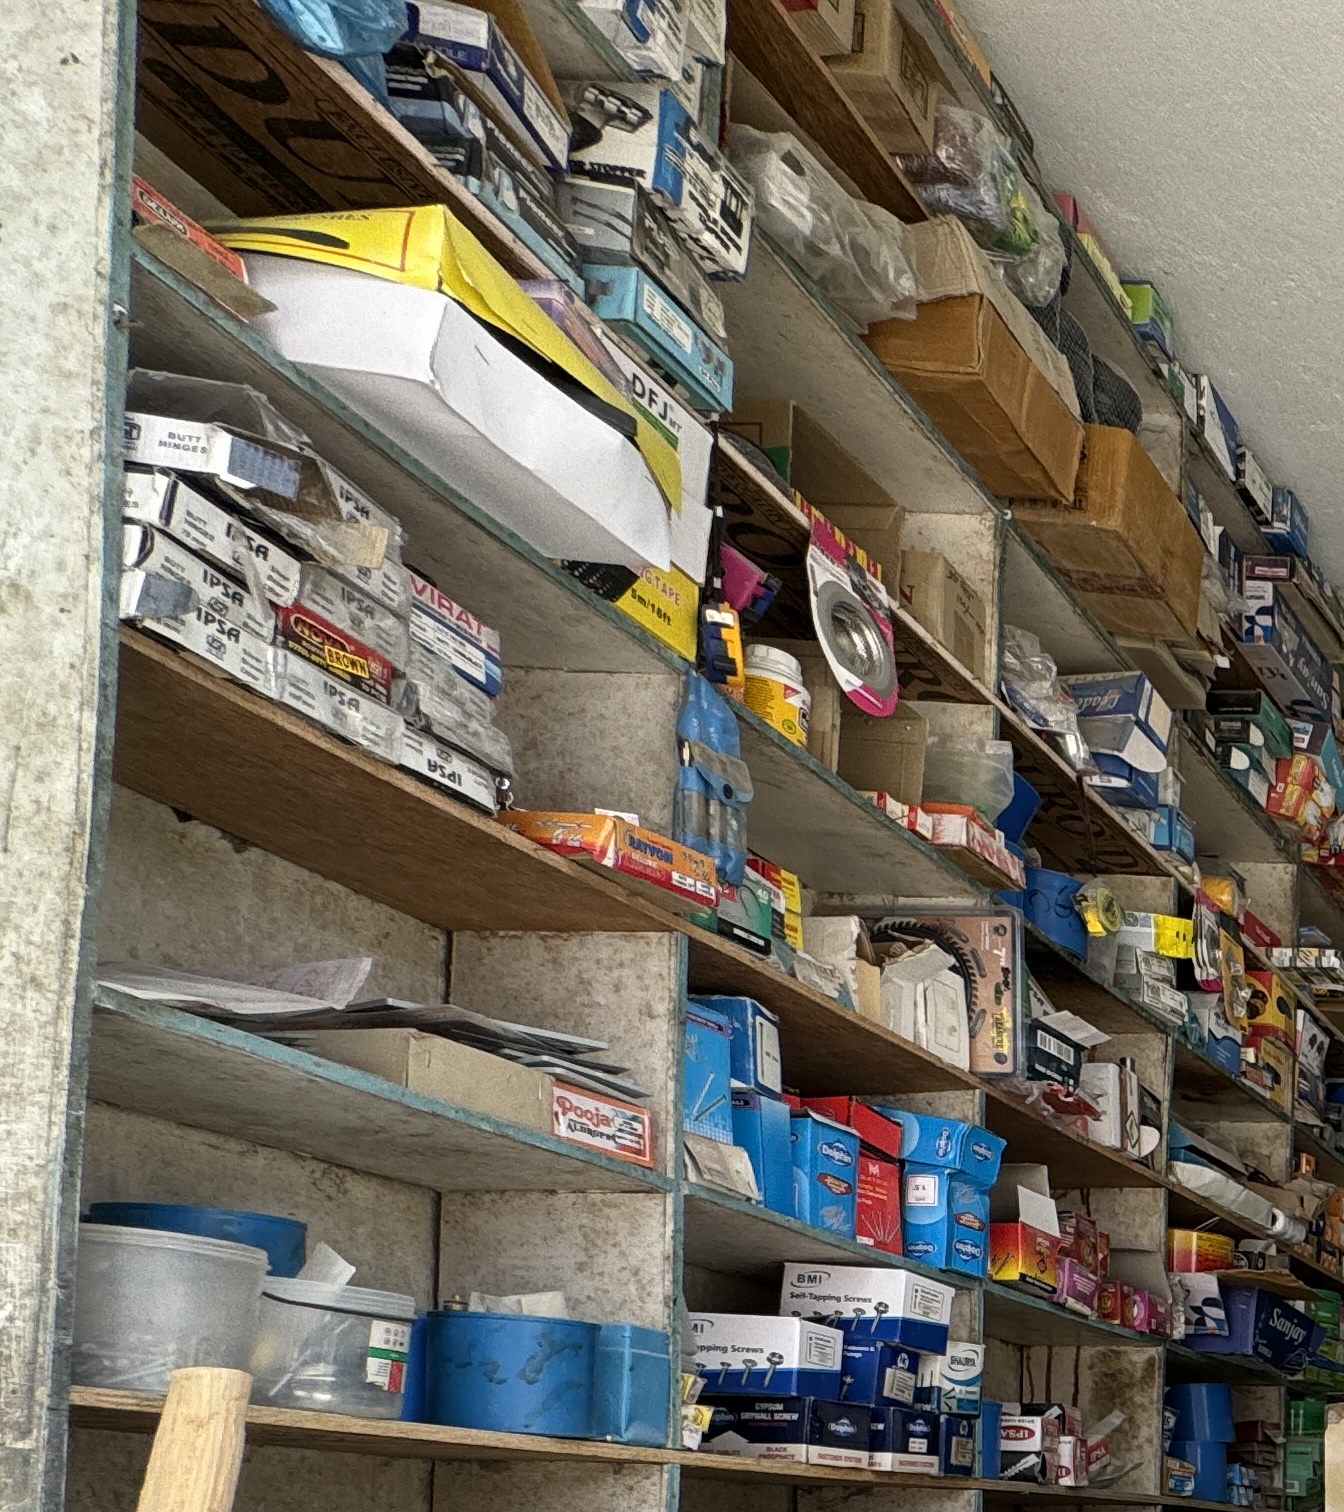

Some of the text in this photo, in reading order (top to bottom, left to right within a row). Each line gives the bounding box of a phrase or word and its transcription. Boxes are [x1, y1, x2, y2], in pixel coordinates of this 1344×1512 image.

[158, 439, 209, 455] HINGES
[167, 431, 202, 444] BUTT
[225, 521, 269, 562] ISA
[202, 568, 246, 607] IPSA
[409, 573, 485, 636] VIRAT
[196, 606, 241, 644] IPSA
[326, 645, 369, 677] BROWN
[323, 680, 361, 713] IPSA
[555, 1095, 612, 1129] Pooja
[821, 1143, 853, 1164] Dolphin
[797, 1273, 823, 1285] BMI
[790, 1291, 873, 1304] Self-Tapping Screws
[1268, 1307, 1308, 1346] Sanjay
[730, 1344, 764, 1354] Screws
